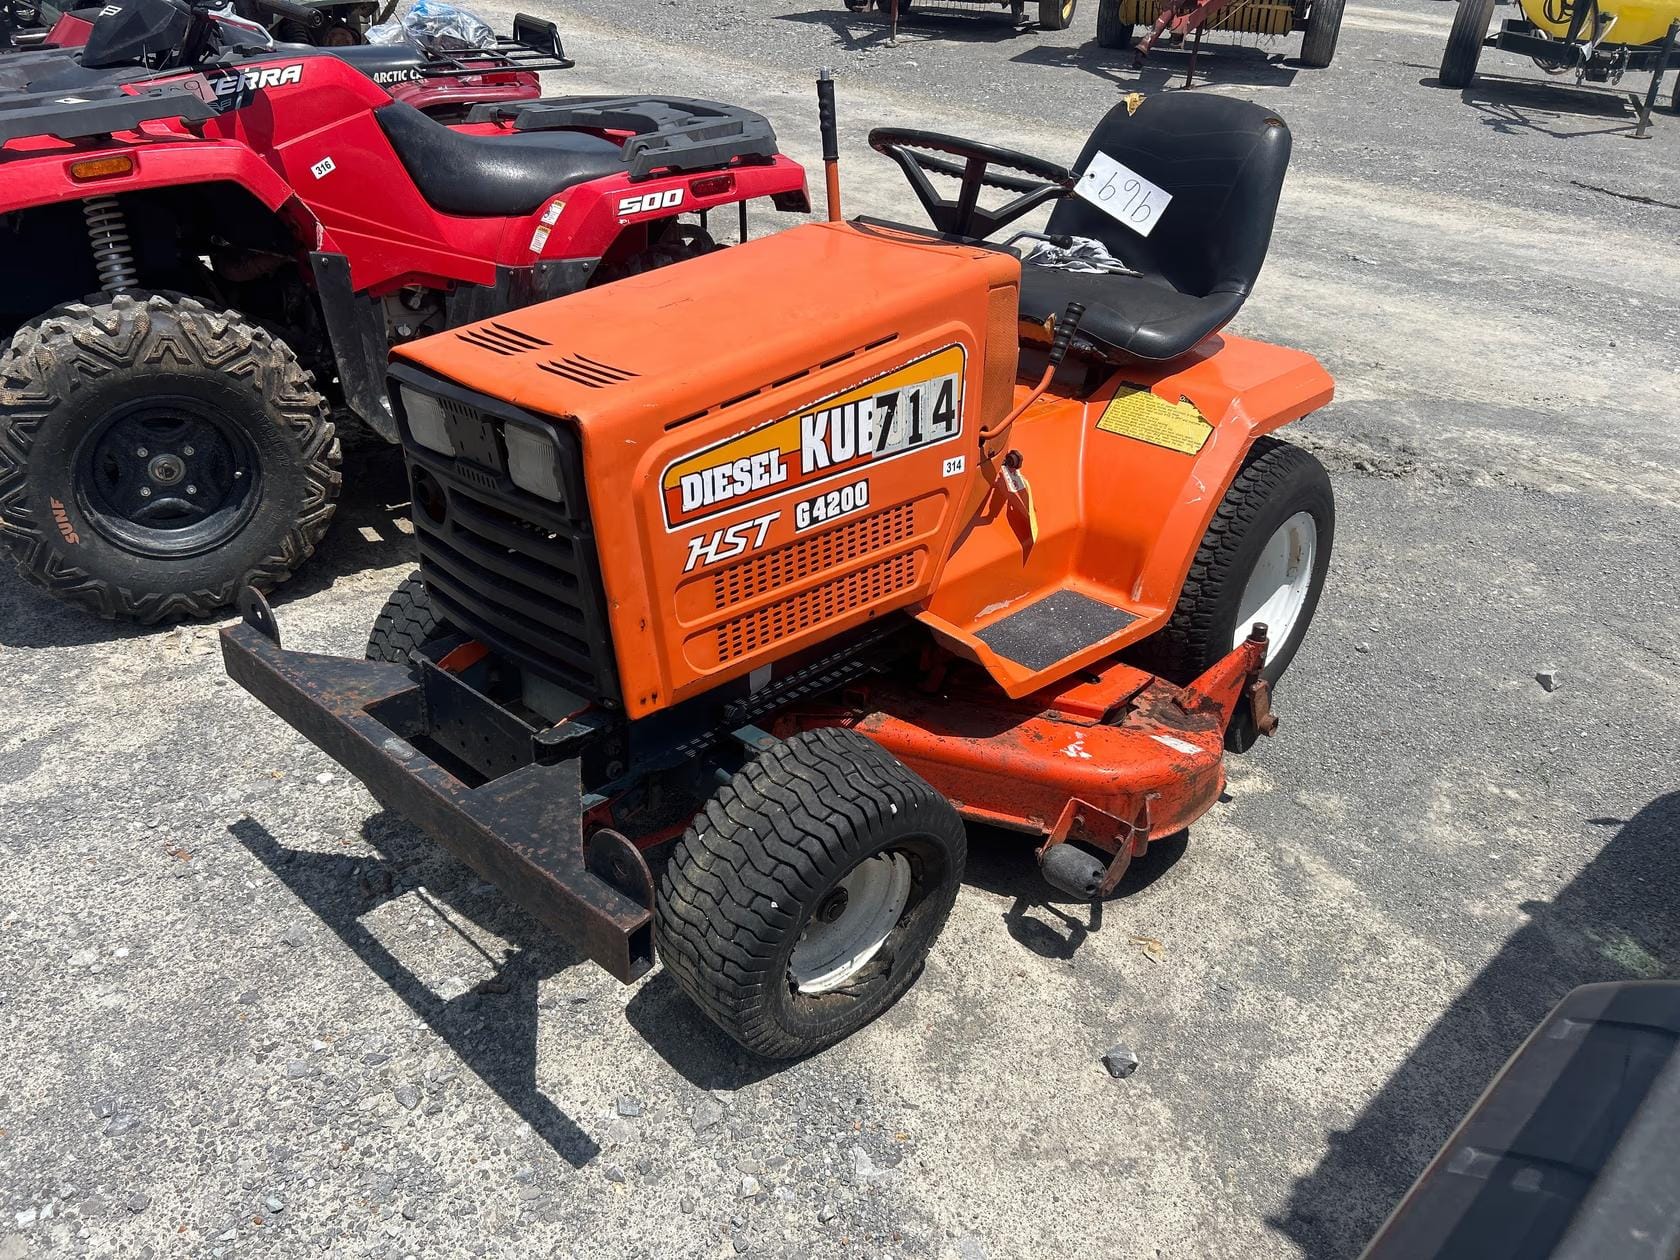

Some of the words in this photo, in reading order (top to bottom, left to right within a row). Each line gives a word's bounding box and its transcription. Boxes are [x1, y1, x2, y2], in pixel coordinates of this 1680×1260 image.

[373, 69, 407, 84] ARCTIC
[410, 69, 424, 80] CA
[315, 160, 332, 175] 316
[618, 189, 683, 215] 500
[875, 378, 956, 453] 714
[680, 448, 787, 512] DIESEL
[801, 403, 873, 475] KUB
[945, 460, 962, 474] 314
[50, 496, 80, 545] SUNF
[795, 480, 868, 529] G4200
[683, 512, 782, 574] HST
